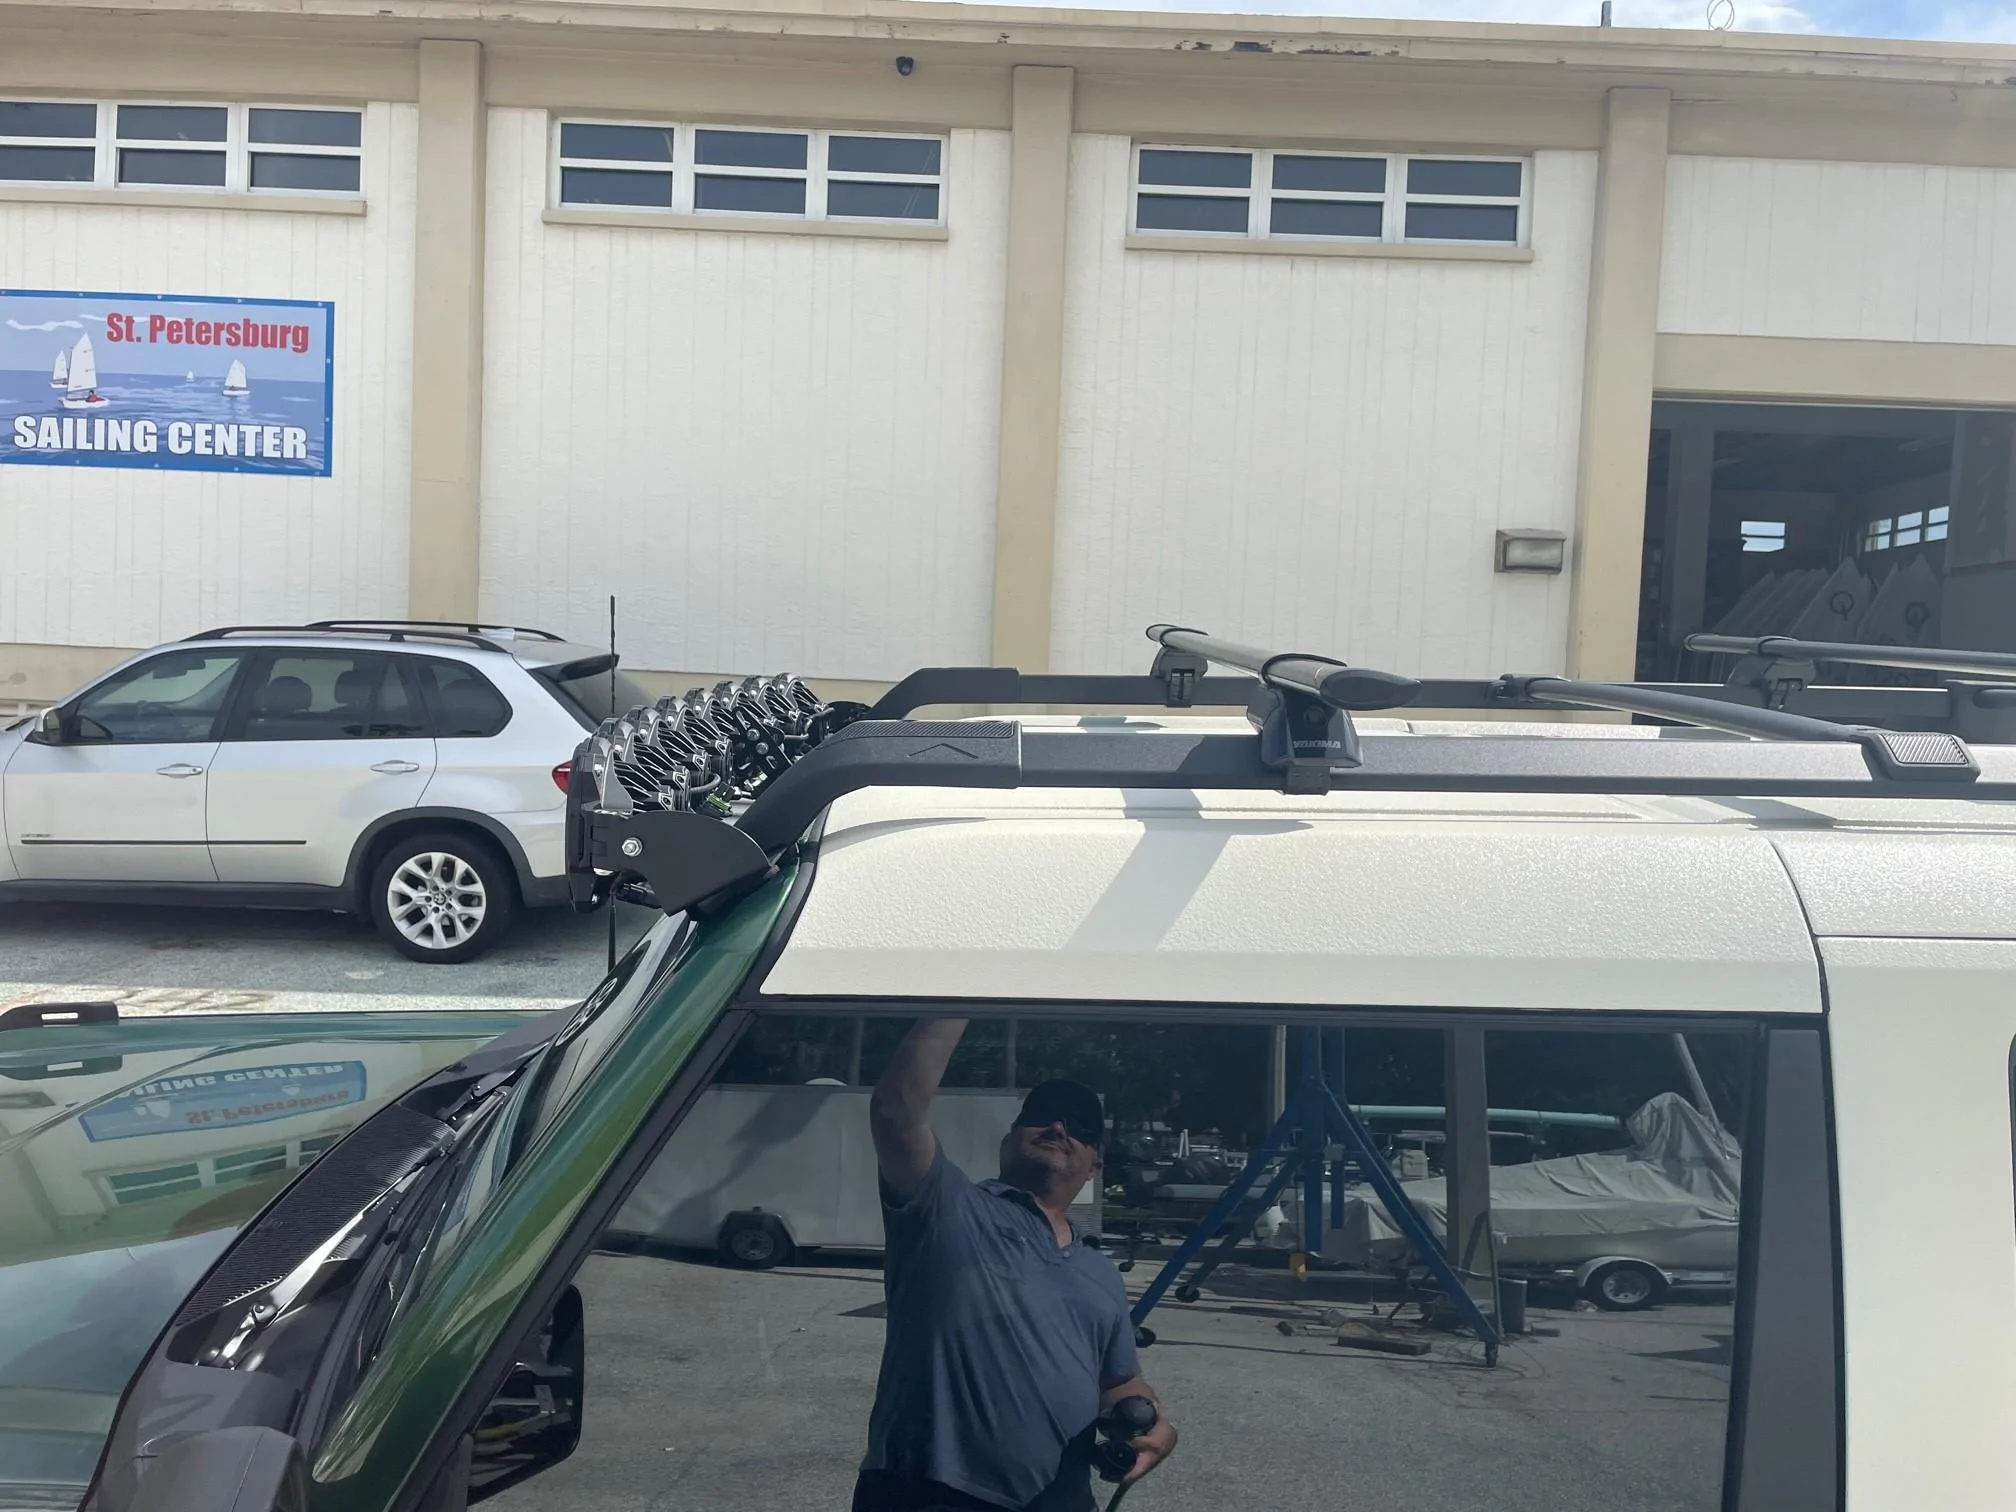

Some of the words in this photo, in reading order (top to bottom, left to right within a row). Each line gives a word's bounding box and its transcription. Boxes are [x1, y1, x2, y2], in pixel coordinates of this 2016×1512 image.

[107, 312, 142, 343] St.
[150, 315, 309, 353] Petersburg
[13, 416, 158, 453] SAILING
[167, 422, 306, 458] CENTER
